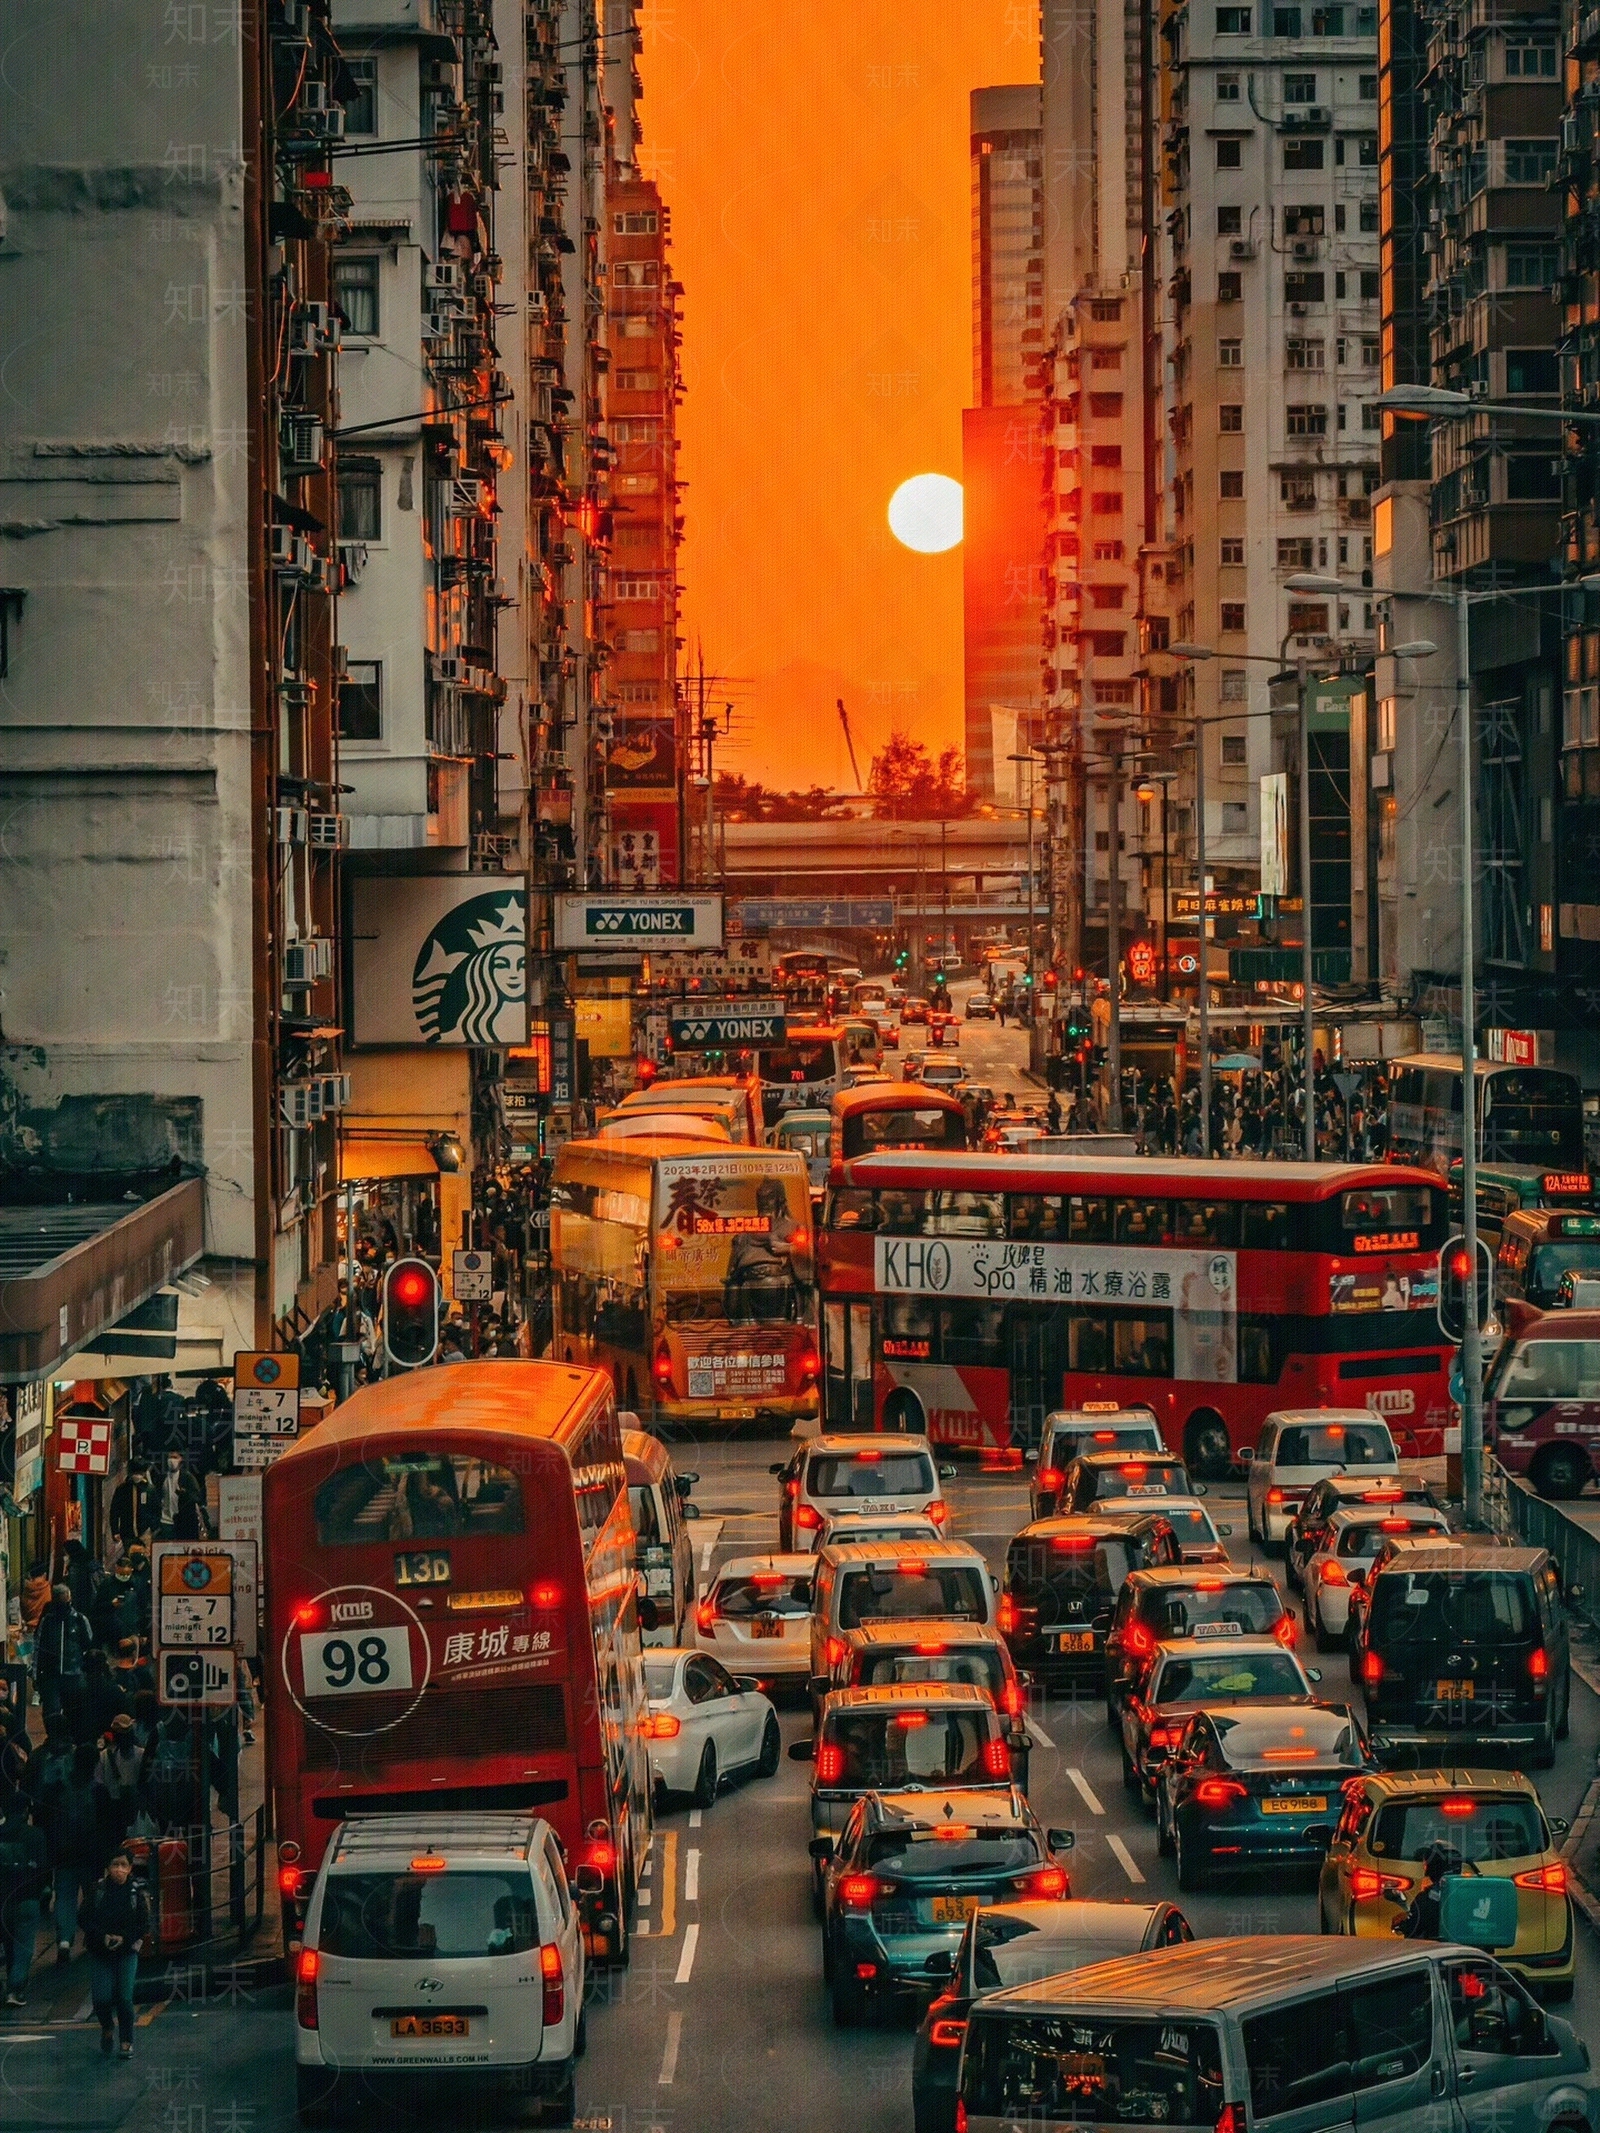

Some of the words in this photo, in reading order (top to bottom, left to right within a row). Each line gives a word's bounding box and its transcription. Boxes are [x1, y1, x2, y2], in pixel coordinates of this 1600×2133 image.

[629, 913, 682, 930] YONEX
[716, 1020, 774, 1039] YONEX
[791, 1071, 805, 1081] 701
[664, 1164, 800, 1176] 2023年2月21日(10時至12時)
[1545, 1175, 1560, 1191] 12A
[478, 1275, 485, 1284] 7
[973, 1260, 1014, 1295] Spa
[1029, 1267, 1171, 1299] 精油水療浴露
[479, 1290, 489, 1299] 12
[246, 1398, 264, 1407] 上午
[276, 1393, 285, 1407] 7
[1086, 1402, 1116, 1410] TAXI
[1366, 1389, 1415, 1415] KMB
[238, 1414, 271, 1422] midnight
[276, 1418, 294, 1432] 12
[862, 1503, 896, 1512] TAXI
[397, 1553, 451, 1585] 13D
[173, 1605, 193, 1615] 上午
[205, 1599, 217, 1616] 7
[331, 1602, 374, 1622] KMB
[164, 1623, 201, 1633] midnight
[207, 1627, 228, 1643] 12
[1198, 1624, 1238, 1635] TAXI
[443, 1625, 551, 1666] 康城專線
[323, 1636, 391, 1689] 98
[1272, 1800, 1288, 1811] EG
[945, 1898, 964, 1909] LS
[395, 2023, 416, 2035] LA
[422, 2021, 465, 2035] 3633
[372, 2055, 489, 2066] WWW.GREENWALLS.COM.HK
